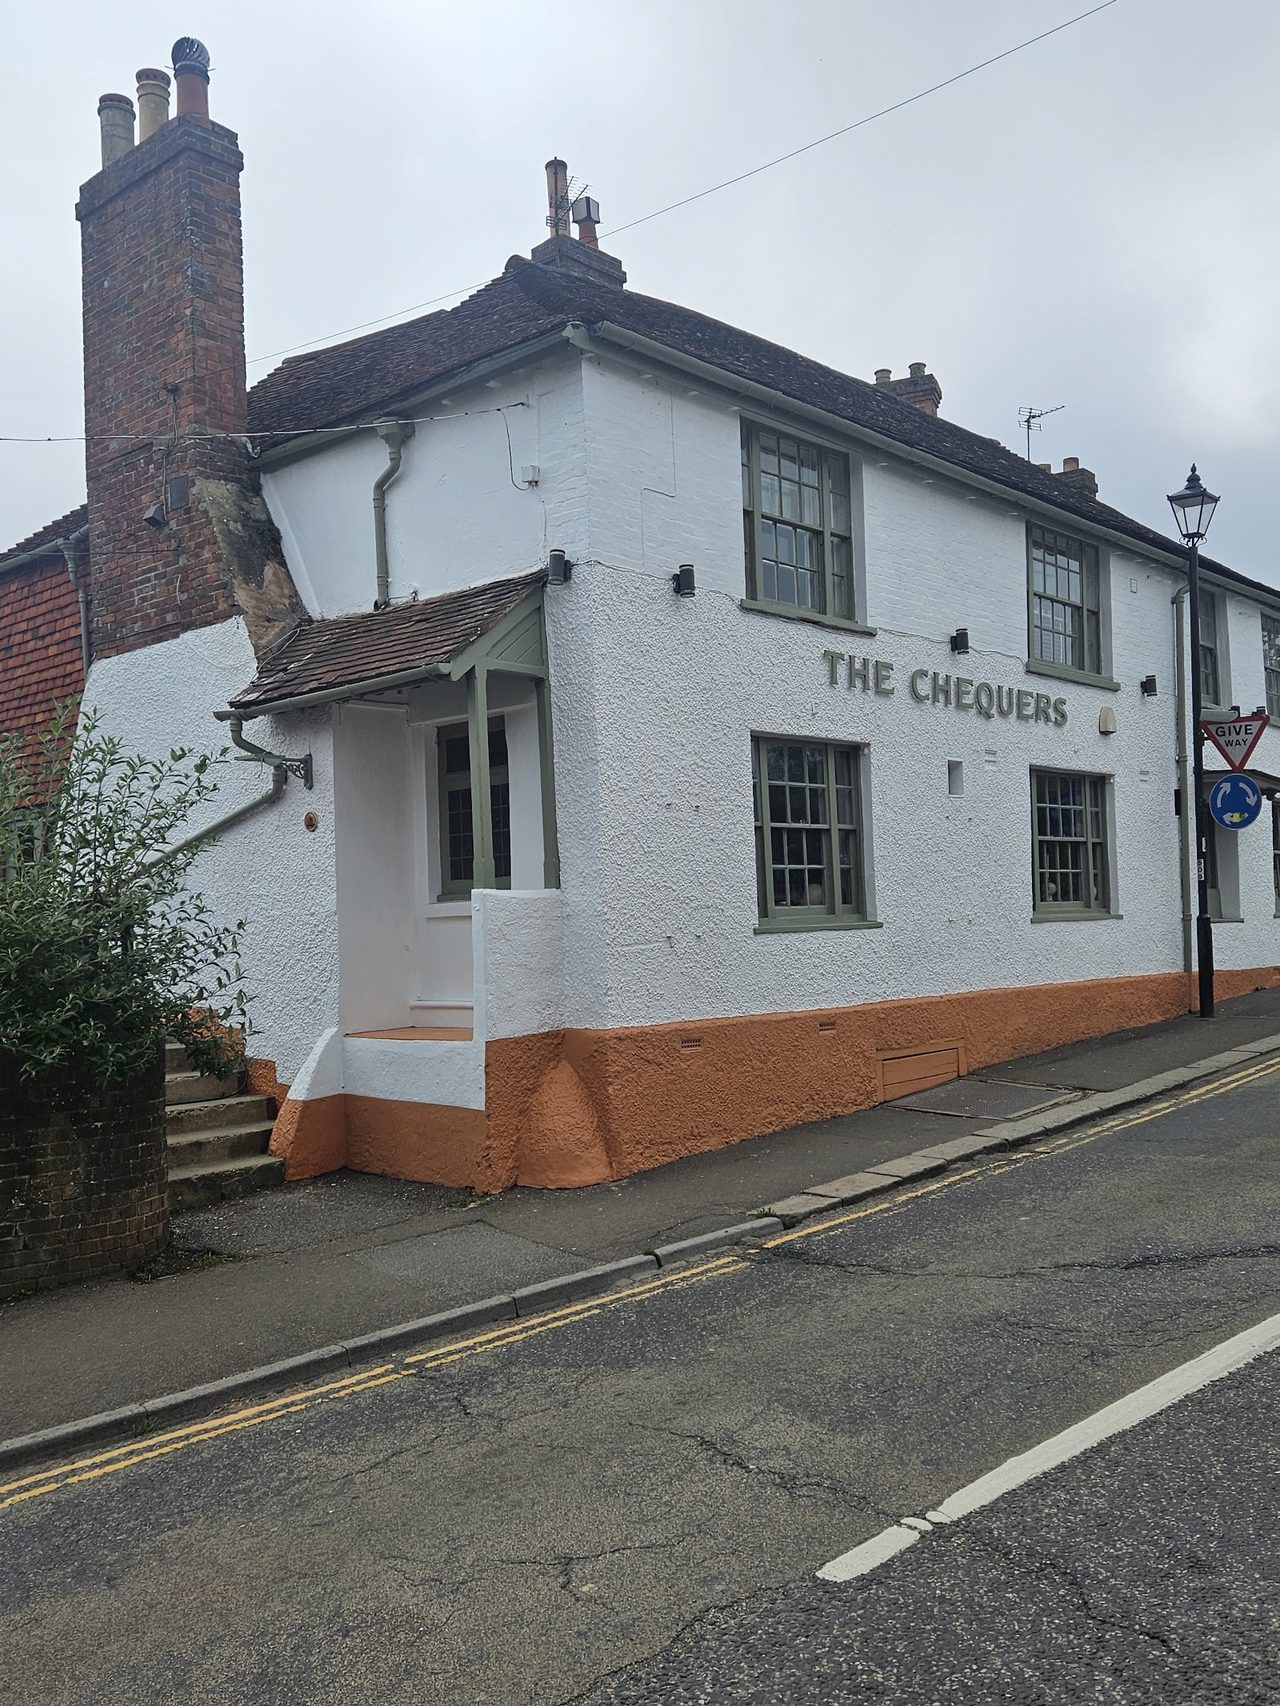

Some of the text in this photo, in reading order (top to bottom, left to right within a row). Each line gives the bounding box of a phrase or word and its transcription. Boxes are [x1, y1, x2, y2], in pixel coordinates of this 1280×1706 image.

[823, 650, 1068, 726] THE CHEQUERS
[1215, 724, 1254, 737] GIVE
[1224, 738, 1248, 748] WAY
